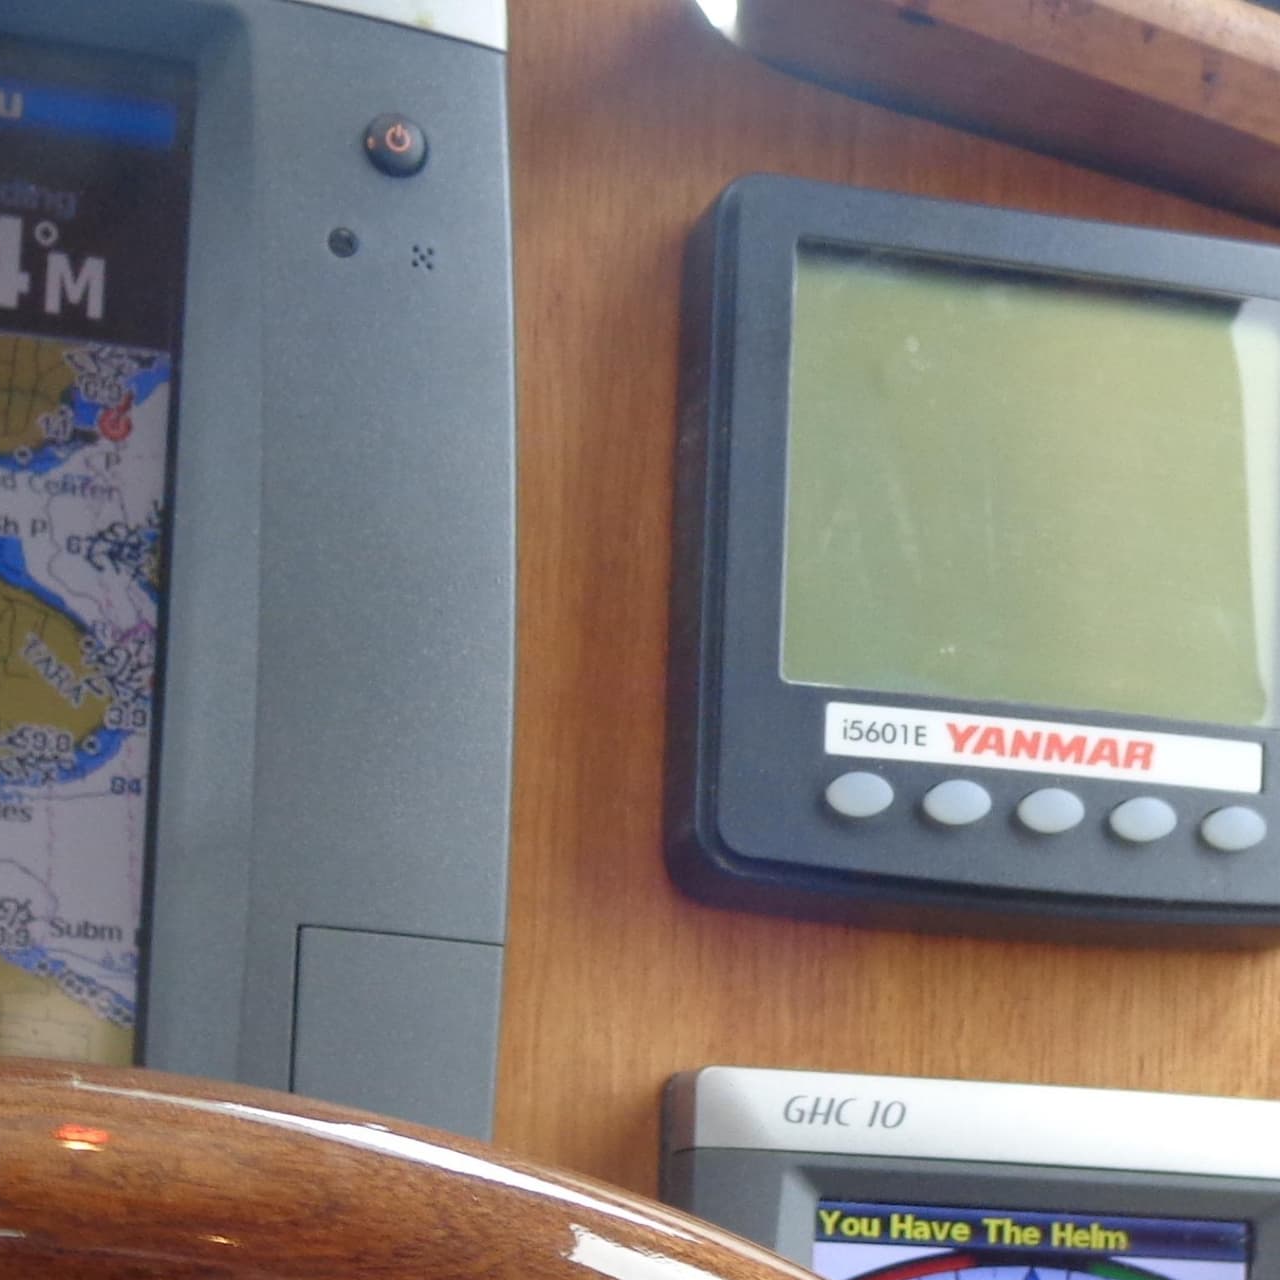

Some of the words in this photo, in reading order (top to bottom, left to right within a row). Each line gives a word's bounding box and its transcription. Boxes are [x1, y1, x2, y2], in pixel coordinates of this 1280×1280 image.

[842, 719, 928, 748] i5601E
[945, 721, 1157, 772] YANMAR
[50, 919, 123, 944] Subm
[782, 1094, 853, 1130] GHC
[867, 1098, 907, 1131] 10
[819, 1209, 881, 1238] You
[889, 1213, 971, 1243] Have
[981, 1217, 1041, 1246] The
[1051, 1220, 1129, 1252] Helm
